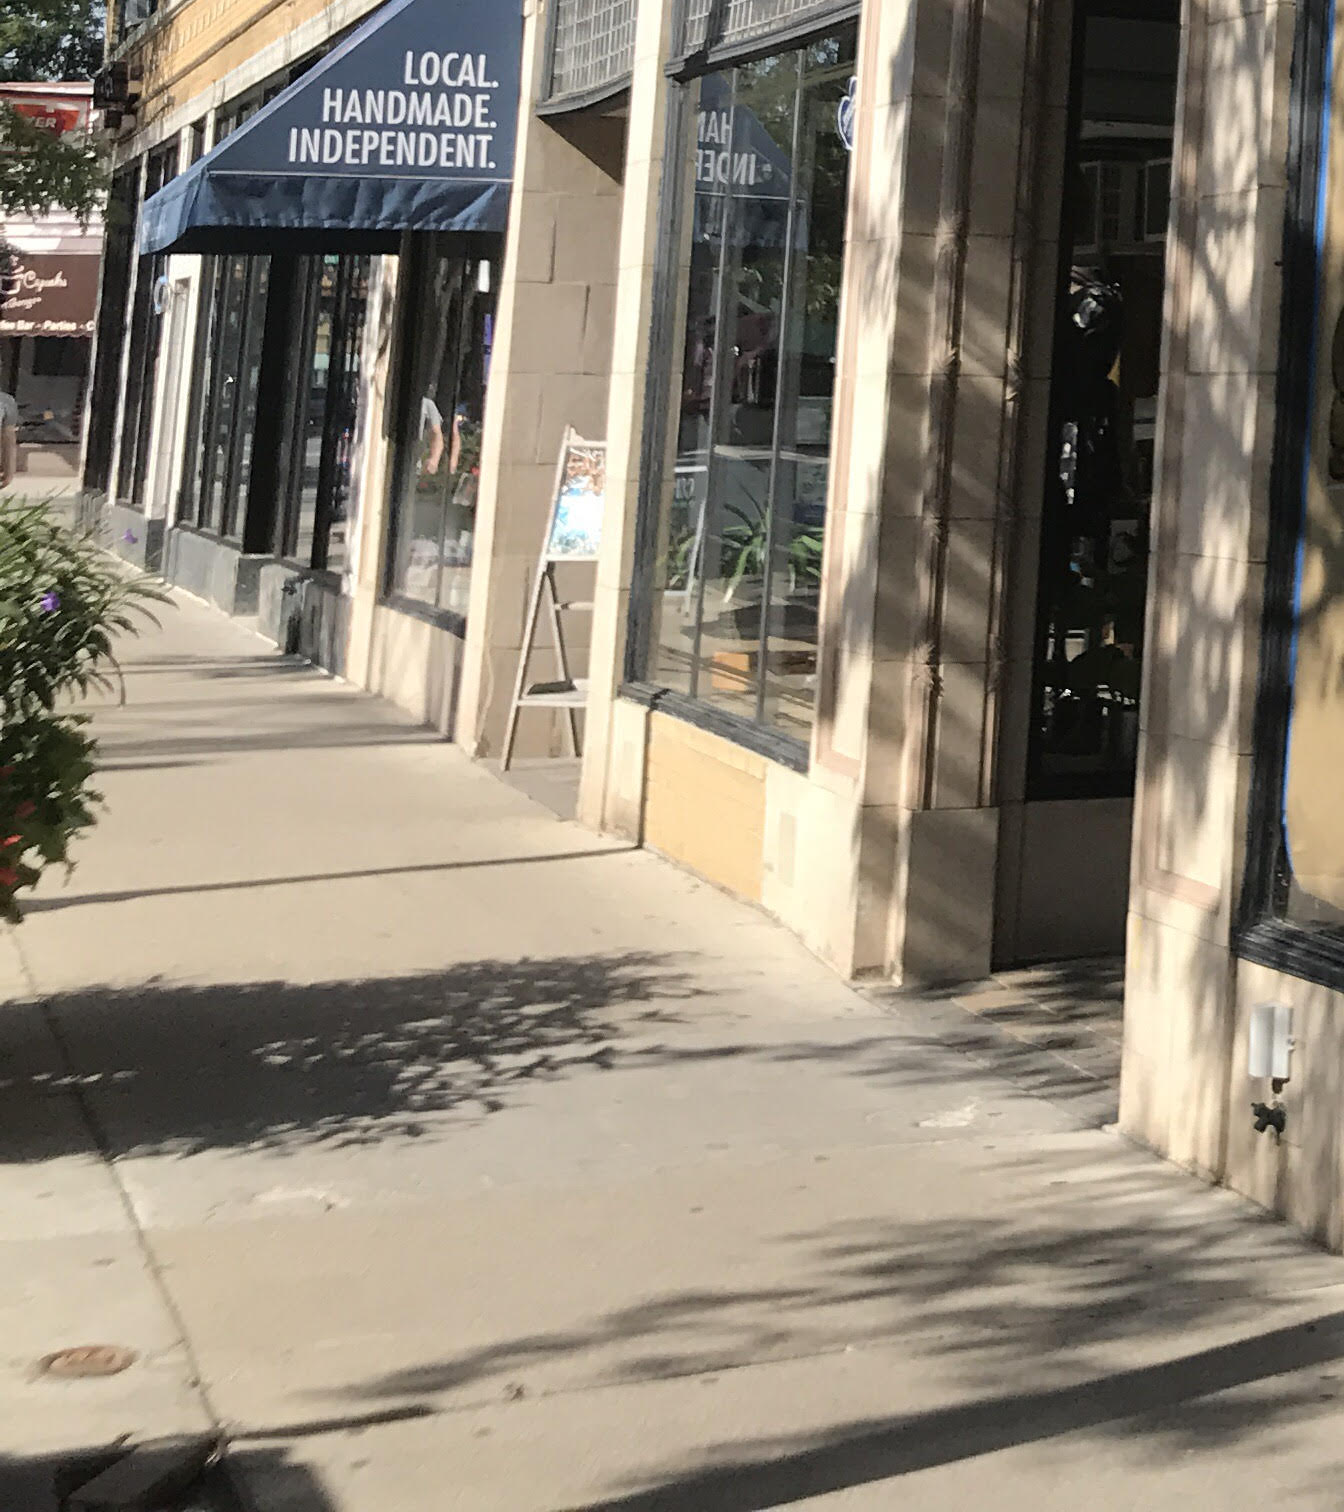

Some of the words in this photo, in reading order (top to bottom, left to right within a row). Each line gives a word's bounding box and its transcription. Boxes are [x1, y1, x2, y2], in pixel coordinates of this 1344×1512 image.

[404, 50, 499, 88] LOCAL.
[322, 88, 498, 128] HANDMADE.
[288, 127, 497, 169] INDEPENDENT.
